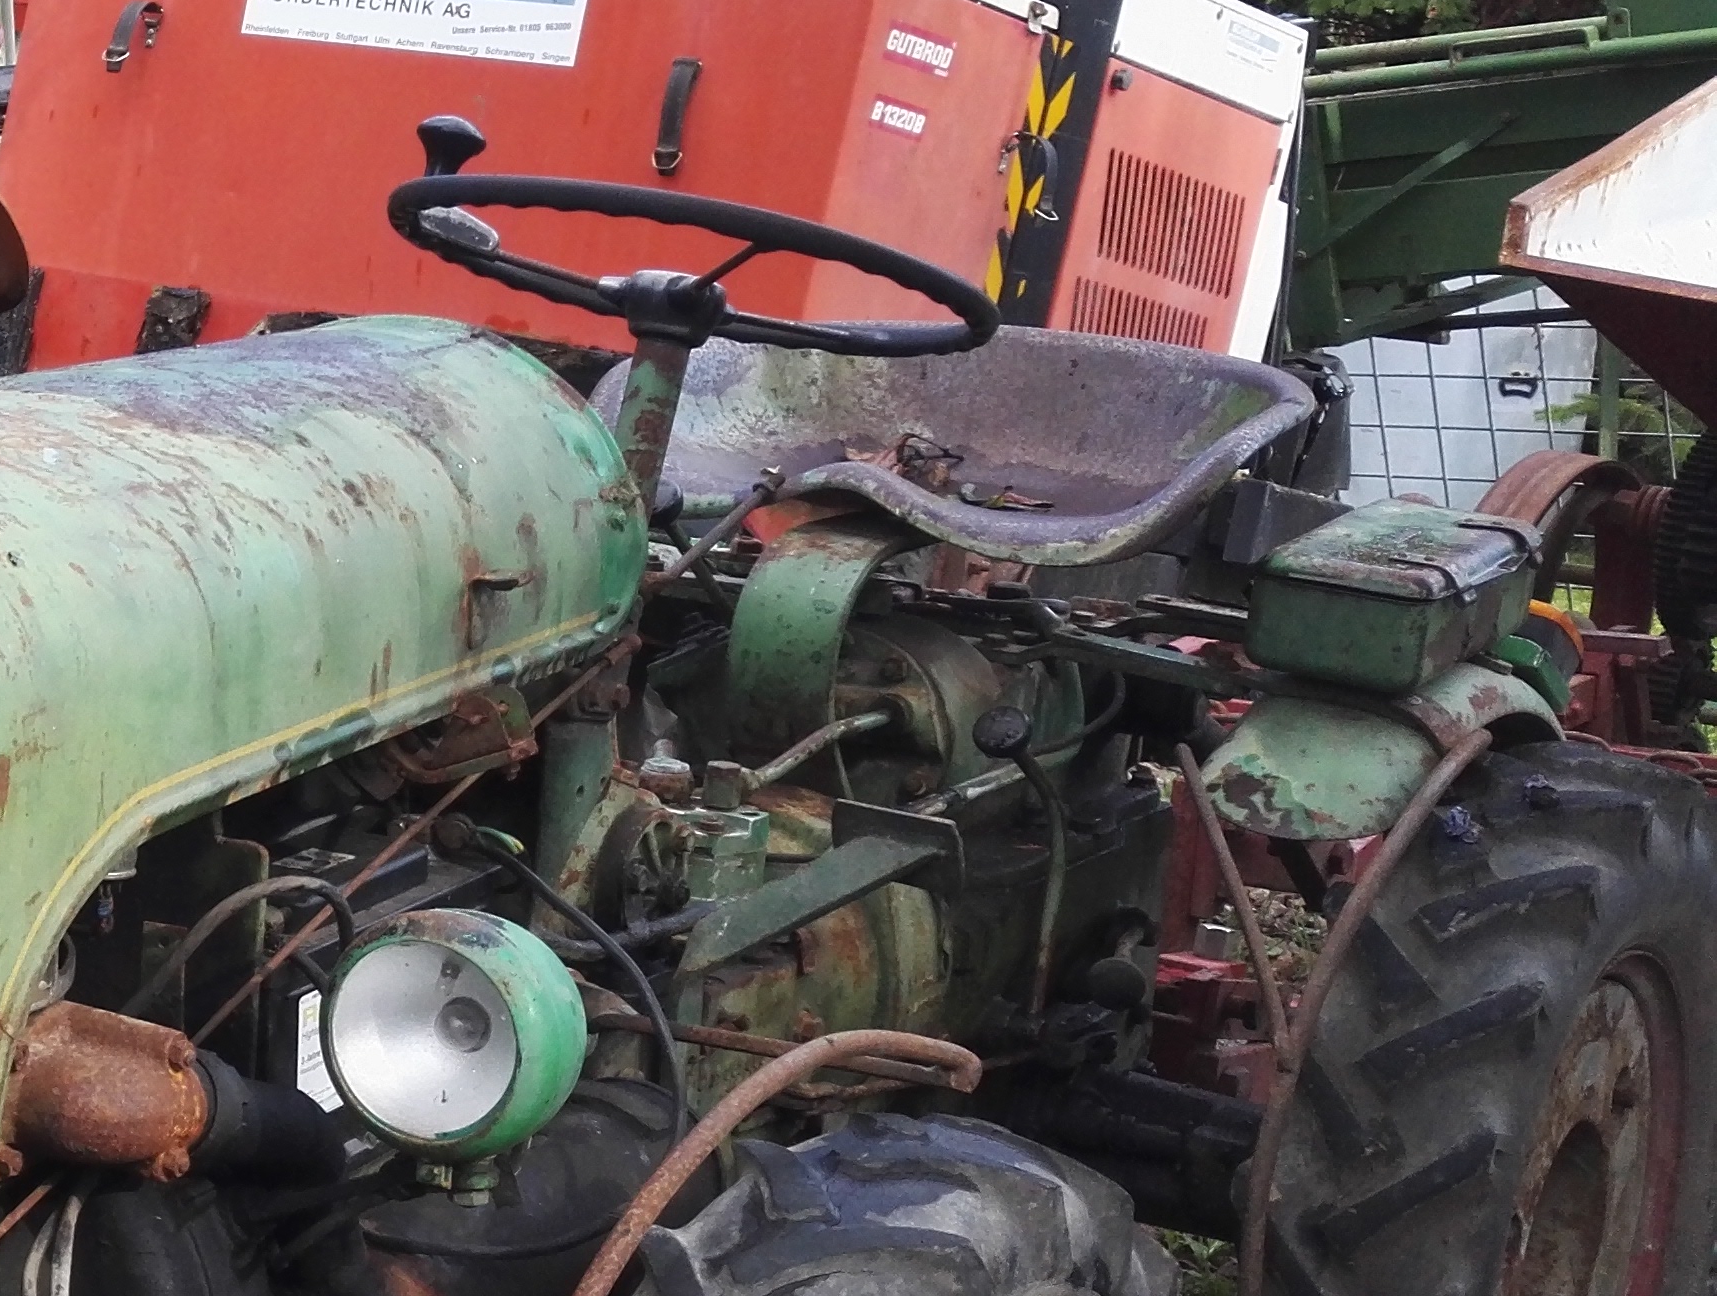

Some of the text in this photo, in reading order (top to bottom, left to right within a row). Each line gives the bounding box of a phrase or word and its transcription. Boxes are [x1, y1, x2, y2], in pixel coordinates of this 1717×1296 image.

[443, 2, 472, 19] AG
[245, 24, 290, 35] Rheinfelden
[297, 29, 330, 41] Freiburg
[336, 32, 368, 44] Stuttgart
[374, 36, 390, 45] Ulm
[431, 41, 479, 56] Ravensburg
[485, 47, 535, 61] Schramberg
[542, 52, 571, 63] Singen
[887, 29, 954, 69] GUTBROD
